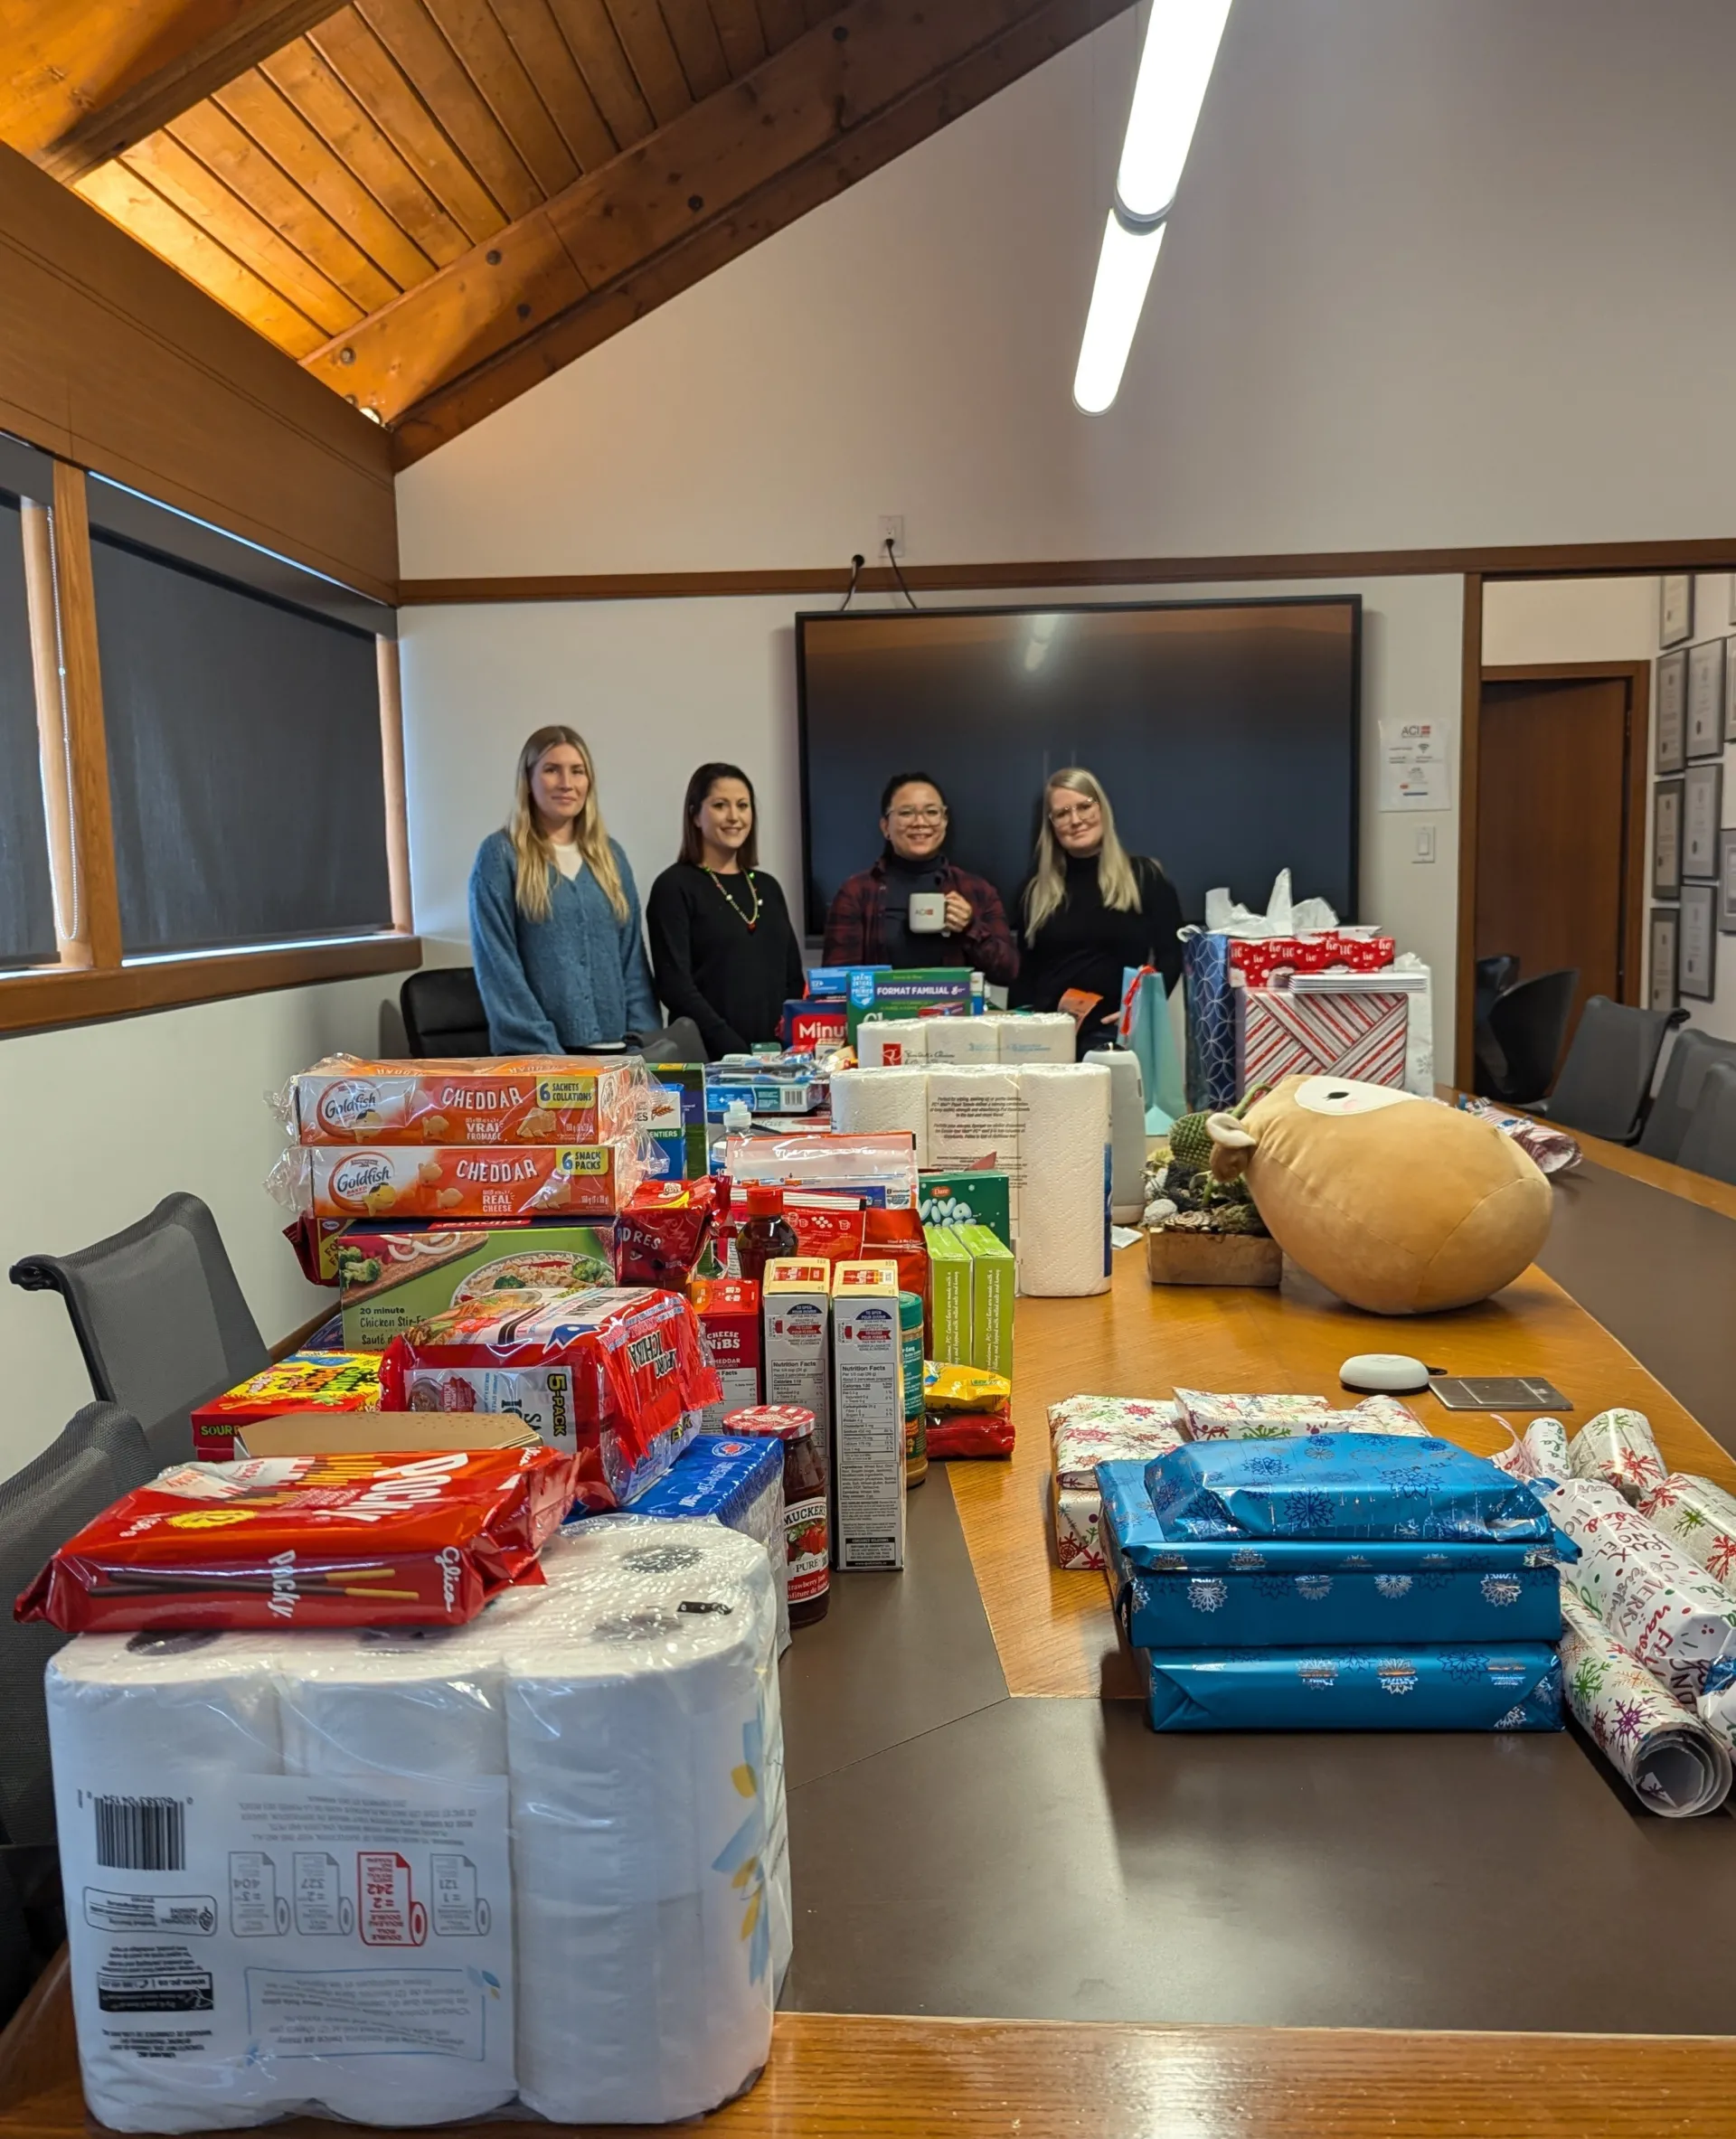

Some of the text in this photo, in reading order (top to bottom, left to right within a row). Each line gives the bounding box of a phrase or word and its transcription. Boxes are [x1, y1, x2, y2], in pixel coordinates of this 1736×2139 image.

[876, 986, 910, 995] FORMAT
[911, 986, 948, 994] FAMILIAL
[800, 1022, 847, 1039] Minu
[540, 1083, 551, 1101] 6
[552, 1083, 579, 1091] SACHETS
[441, 1087, 524, 1110] CHEDDAR
[552, 1092, 591, 1101] COLLATIONS
[326, 1093, 376, 1118] Goldfish
[467, 1133, 501, 1141] FROMAGE
[561, 1152, 573, 1170] 6
[575, 1152, 601, 1160] SNACK
[457, 1159, 538, 1183] CHEDDAR
[575, 1161, 601, 1170] PACKS
[337, 1166, 389, 1192] Goldfish
[483, 1195, 512, 1204] REAL
[483, 1204, 512, 1212] CHEESE
[360, 1316, 396, 1328] Chicken
[363, 1334, 385, 1345] Sauté
[548, 1373, 567, 1437] 5-PACK
[201, 1425, 232, 1437] SOUR
[796, 1559, 818, 1573] PURE
[434, 1546, 460, 1613] Glico
[788, 1578, 817, 1591] trawberry
[367, 1883, 394, 1894] 242
